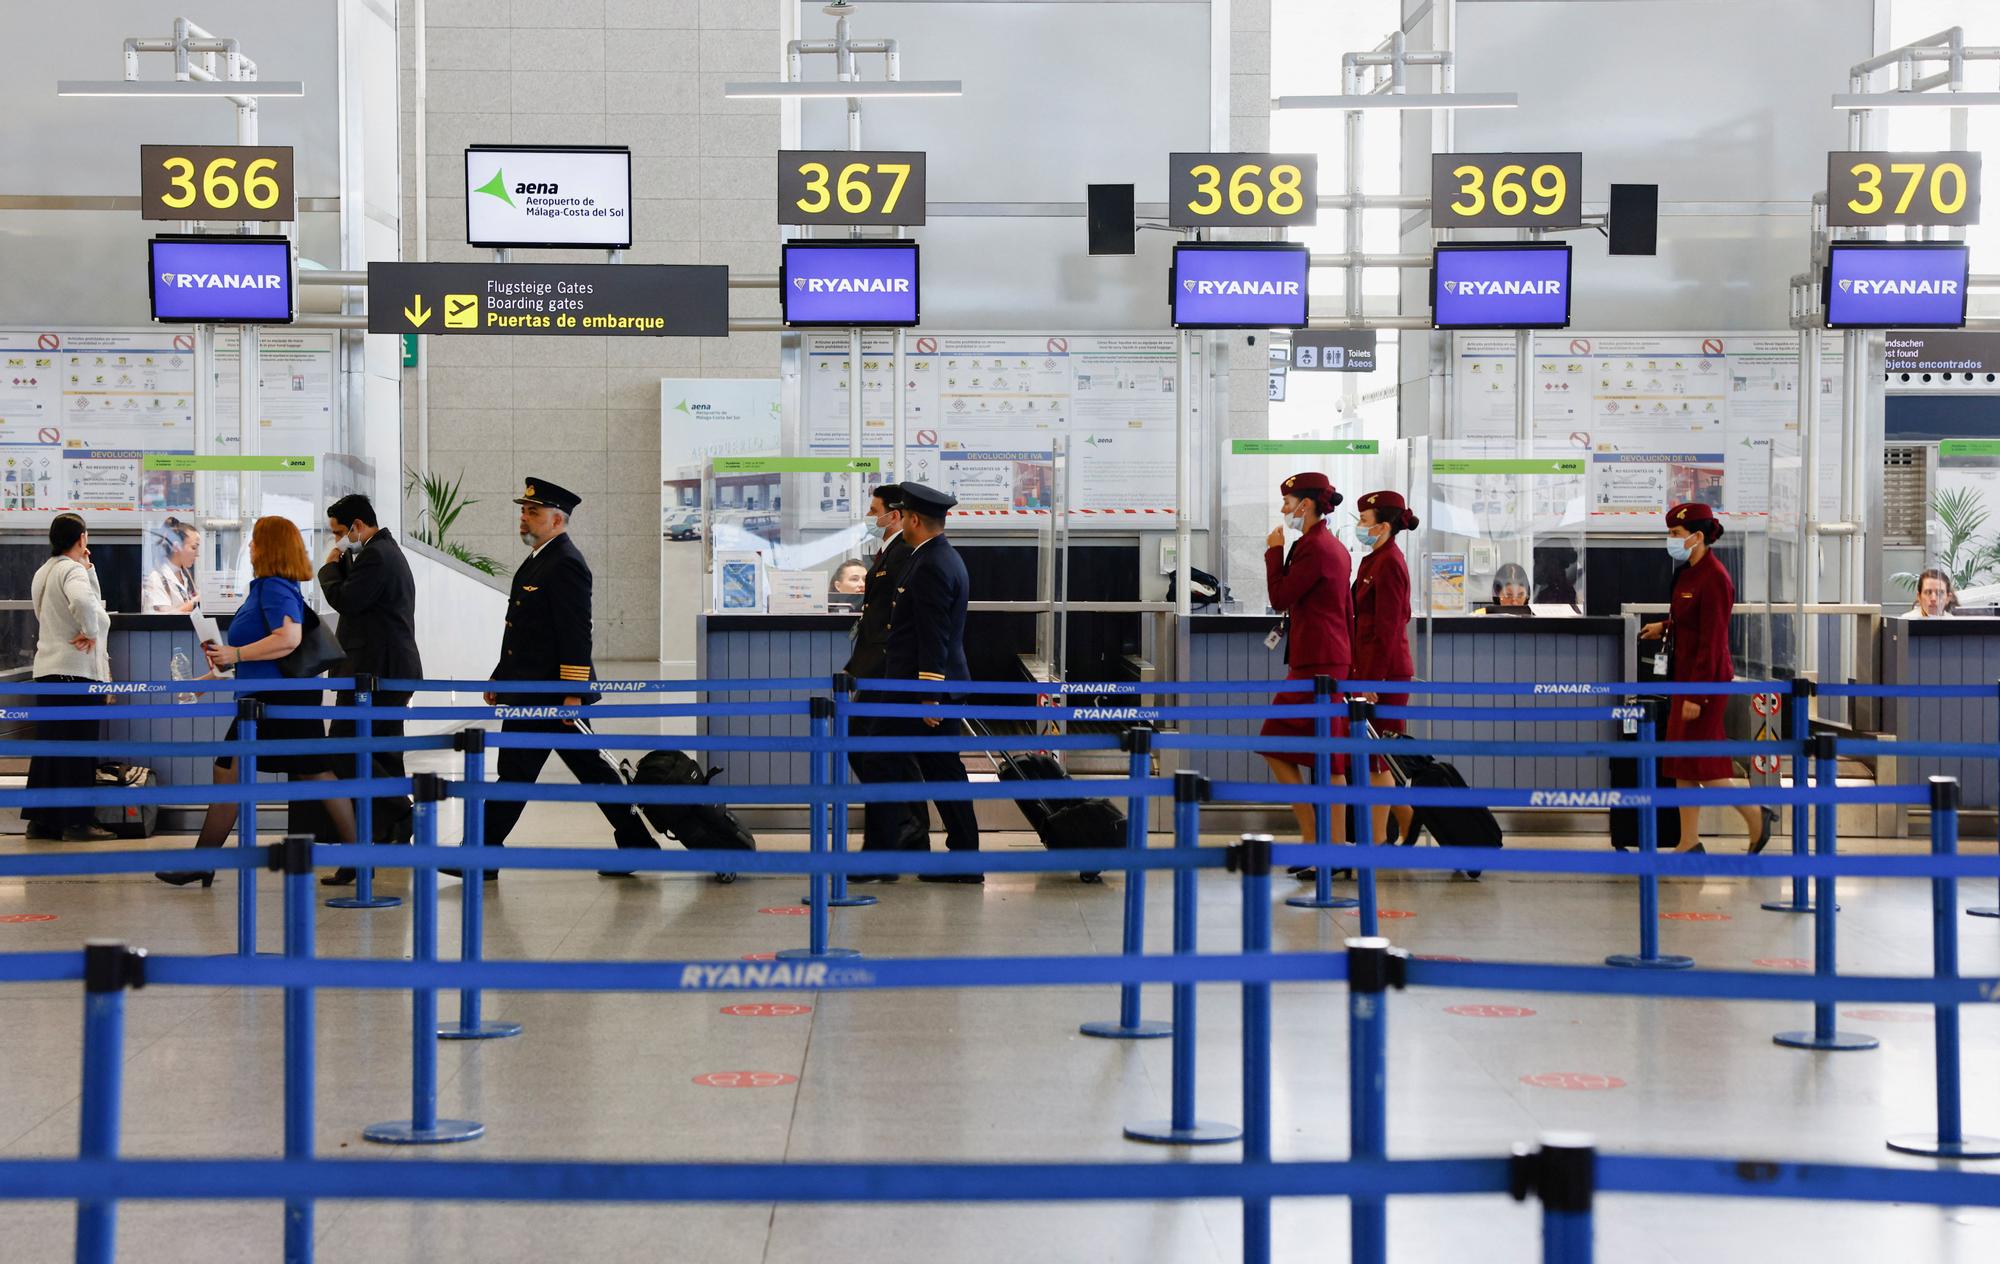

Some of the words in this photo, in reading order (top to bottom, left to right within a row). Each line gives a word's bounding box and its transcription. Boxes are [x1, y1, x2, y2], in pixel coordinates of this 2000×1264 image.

[161, 157, 280, 209] 366
[515, 182, 559, 195] aena
[796, 162, 911, 213] 367
[1188, 164, 1303, 215] 368
[1451, 164, 1567, 216] 369
[1847, 163, 1967, 214] 370
[526, 197, 580, 207] Aeropuerto
[583, 197, 595, 206] de
[526, 207, 590, 218] Málaga-Costa
[592, 208, 607, 217] del
[609, 208, 624, 217] Sol
[177, 273, 281, 289] RYANAIR
[487, 280, 552, 296] Flugsteige
[557, 281, 593, 295] Gates
[808, 278, 909, 293] RYANAIR
[1199, 280, 1299, 295] RYANAIR
[1458, 280, 1561, 295] RYANAIR
[1853, 279, 1958, 295] RYANAIR
[487, 296, 544, 312] Boarding
[549, 299, 584, 312] gates
[487, 313, 550, 327] Puertas
[556, 313, 576, 328] de
[582, 314, 665, 331] embarque
[1884, 339, 1924, 347] undsachen
[1347, 349, 1371, 358] Toilets
[1347, 359, 1373, 367] Aseos
[1885, 360, 1917, 369] bjetos
[1919, 360, 1982, 368] encontrados
[88, 683, 167, 693] RYANAIR.COM
[1060, 683, 1136, 693] RYANAIR.COM
[1533, 684, 1610, 694] RYANAIR.COM
[494, 707, 579, 718] RYANAIR.COM
[1073, 708, 1159, 719] RYANAIR.COM
[1530, 791, 1651, 807] RYANAIR.COM
